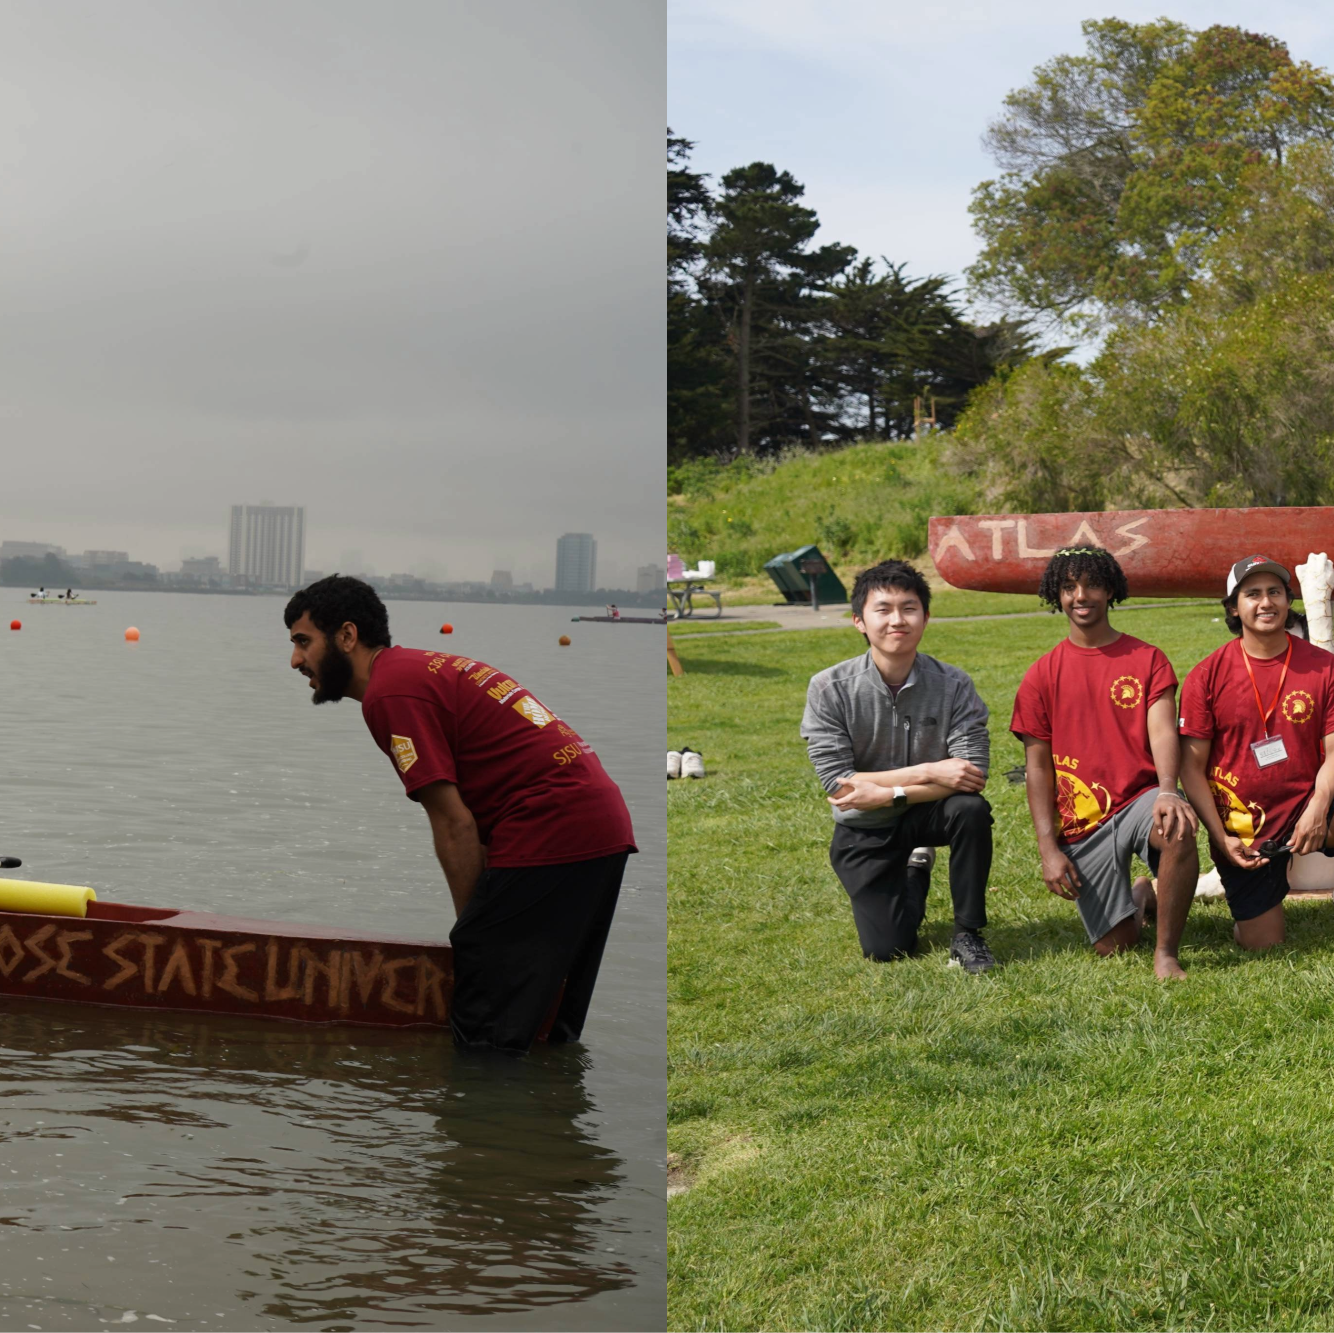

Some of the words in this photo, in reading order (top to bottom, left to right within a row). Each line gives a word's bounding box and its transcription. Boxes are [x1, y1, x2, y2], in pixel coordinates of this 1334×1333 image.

[935, 517, 1151, 563] ATLAS
[553, 743, 582, 766] SJSU
[1053, 753, 1080, 770] TLAS
[101, 932, 260, 1002] STATE
[265, 934, 454, 1021] UNIVER
